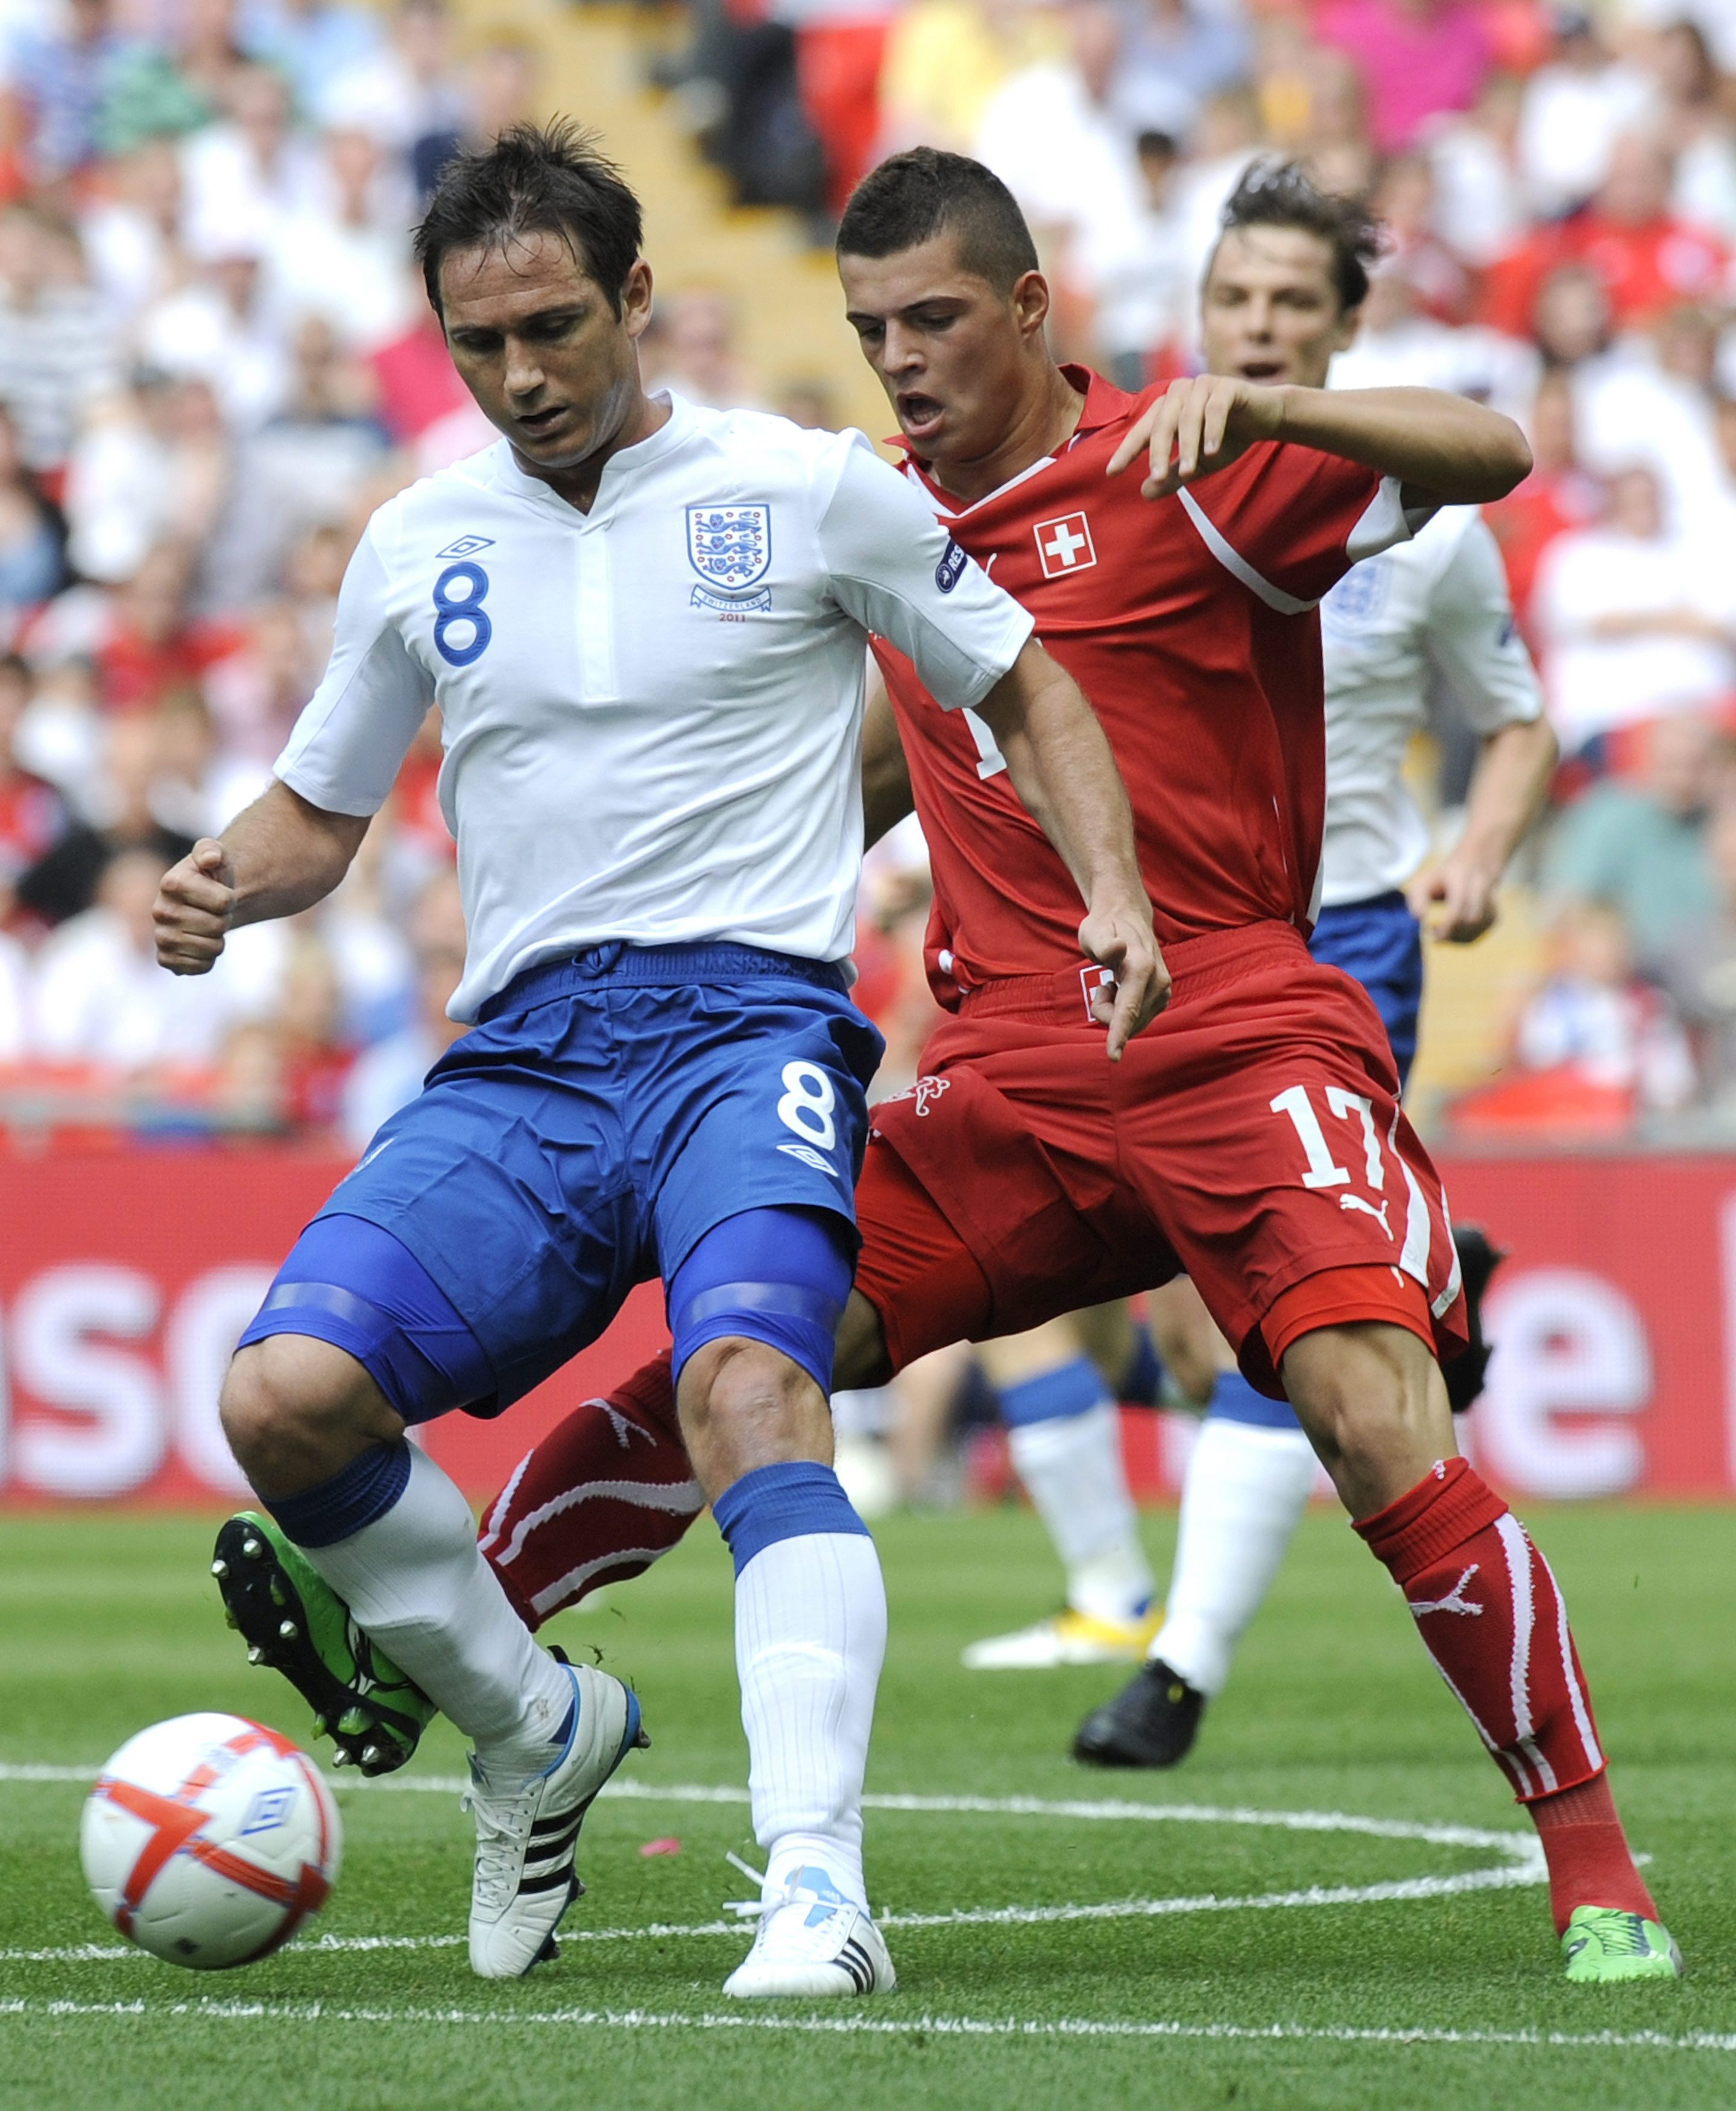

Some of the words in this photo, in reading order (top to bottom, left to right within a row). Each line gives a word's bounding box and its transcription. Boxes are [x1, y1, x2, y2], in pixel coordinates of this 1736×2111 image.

[432, 562, 492, 667] 8
[703, 594, 762, 609] SWITZERLAND
[719, 613, 746, 622] 2011
[962, 707, 1008, 780] 1
[777, 1060, 836, 1151] 8
[1269, 1084, 1385, 1191] 17
